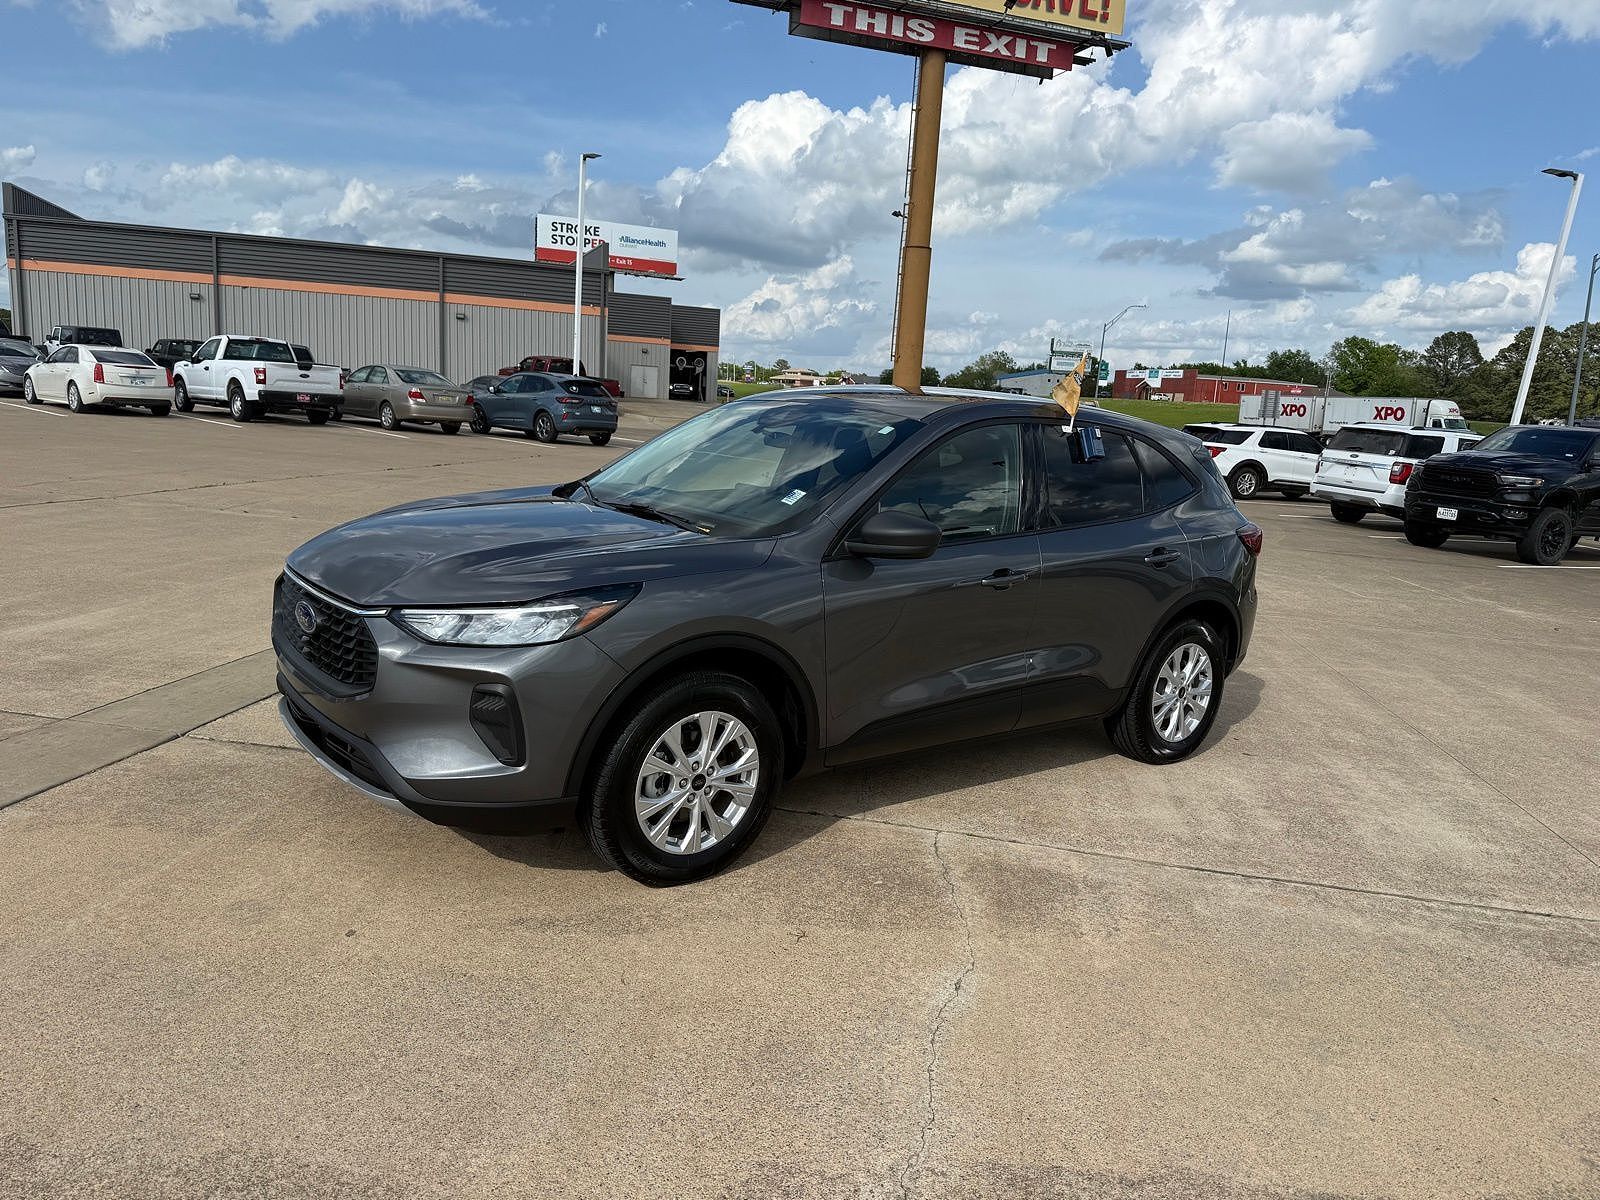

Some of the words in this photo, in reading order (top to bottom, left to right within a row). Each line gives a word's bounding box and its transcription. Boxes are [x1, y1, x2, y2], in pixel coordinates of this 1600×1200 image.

[822, 2, 936, 42] THIS
[952, 25, 1057, 63] EXIT
[619, 235, 667, 248] AllianceHealth
[1280, 404, 1307, 418] XPO
[1373, 406, 1406, 422] XPO
